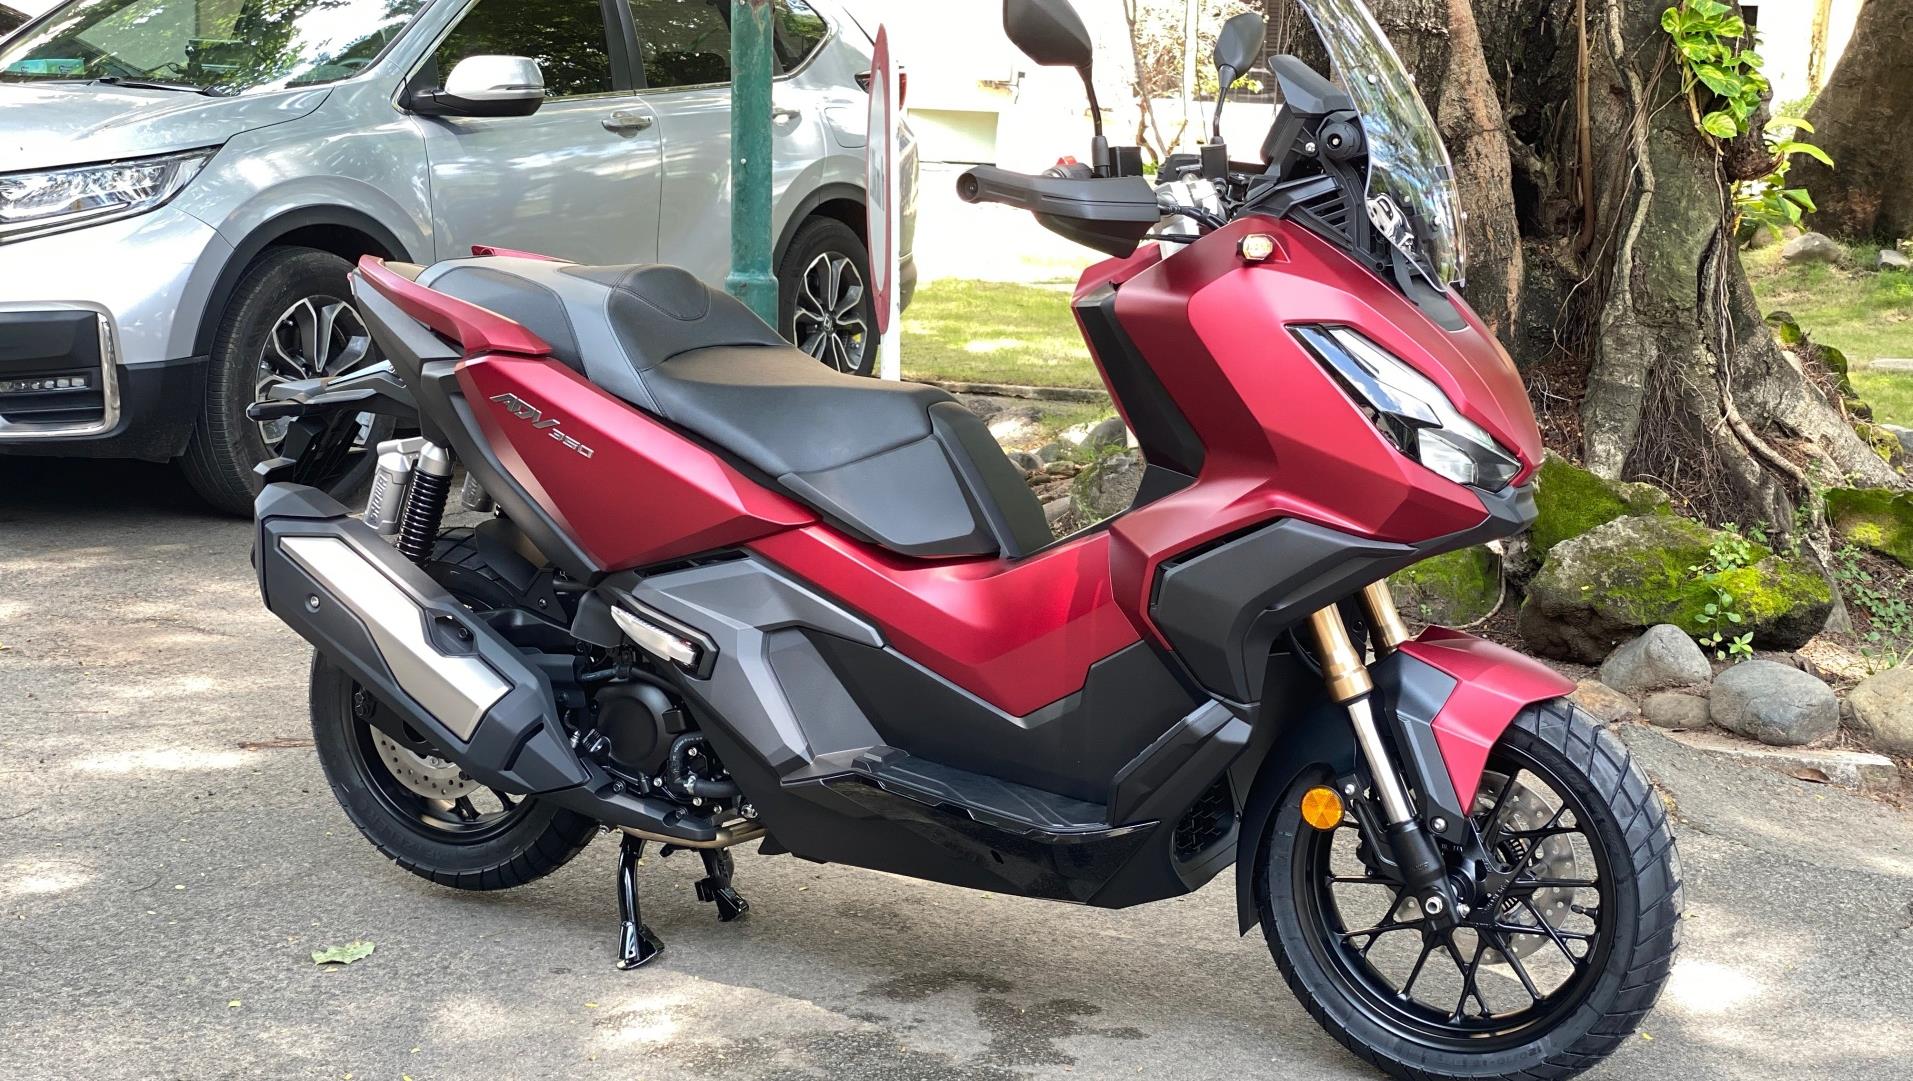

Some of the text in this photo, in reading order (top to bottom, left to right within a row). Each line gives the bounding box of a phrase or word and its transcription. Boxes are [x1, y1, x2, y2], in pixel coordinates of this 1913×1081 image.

[489, 392, 594, 458] ADV 350
[370, 473, 388, 518] SHOWA
